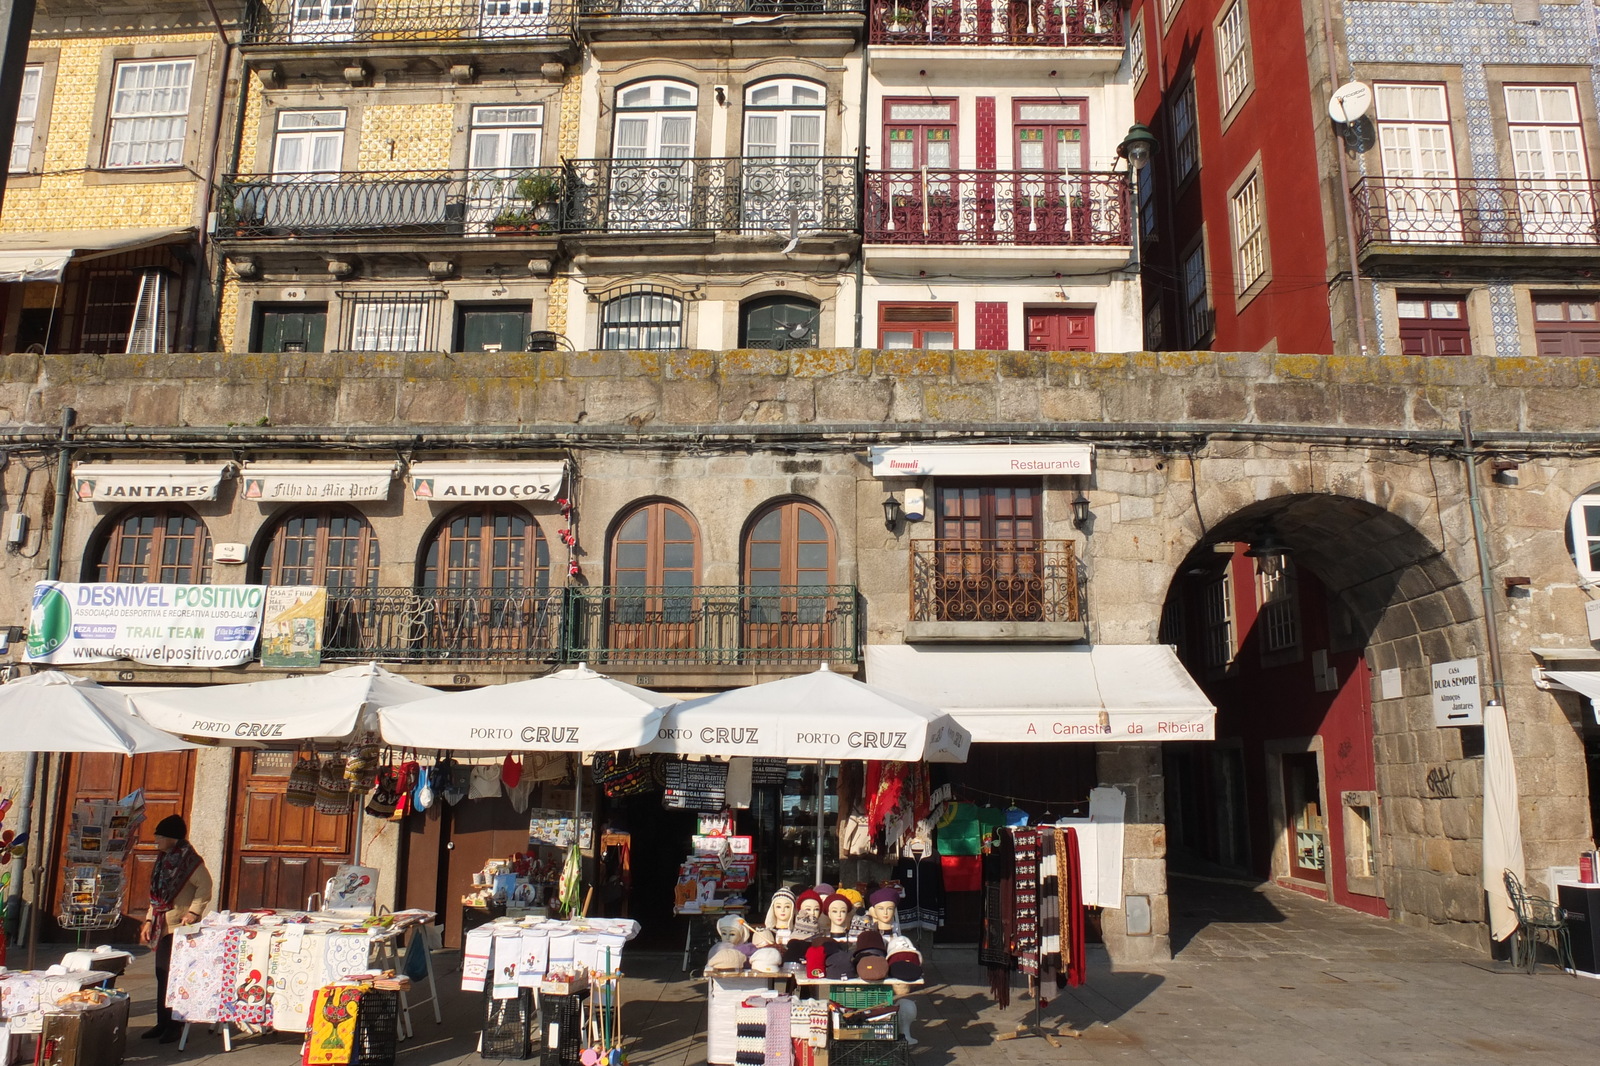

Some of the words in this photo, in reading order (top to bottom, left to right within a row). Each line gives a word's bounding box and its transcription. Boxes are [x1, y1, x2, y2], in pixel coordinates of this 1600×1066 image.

[1010, 459, 1081, 470] Restaurante
[103, 485, 210, 497] JANTARES
[270, 482, 302, 498] Filha
[306, 484, 318, 496] da
[349, 482, 379, 498] Preta
[443, 484, 551, 499] ALMOÇOS
[76, 585, 170, 607] DESNIVEL
[174, 586, 263, 609] POSITIVO
[74, 607, 120, 618] ASSOCIAÇÃO
[120, 609, 161, 617] DESPORTIVA
[168, 610, 210, 618] RECREATIVA
[126, 626, 164, 638] TRAIL
[167, 626, 205, 639] TEAM
[72, 644, 253, 662] www.desnivelpositivo.com
[1451, 675, 1477, 687] SEMPRE
[1451, 703, 1474, 711] Jantares
[192, 720, 230, 733] PORTO
[234, 722, 286, 737] CRUZ
[470, 727, 513, 739] PORTO
[520, 726, 579, 744] CRUZ
[657, 728, 693, 740] ORTO
[699, 726, 759, 744] CRUZ
[1026, 723, 1037, 734] A
[1052, 722, 1112, 734] Canastra
[1127, 723, 1143, 734] da
[1158, 721, 1204, 733] Ribeira
[796, 732, 840, 744] PORTO
[847, 731, 907, 749] CRUZ
[672, 789, 701, 797] PORTUGAL
[239, 940, 247, 975] PORTUGAL
[271, 943, 280, 975] PORTUGA
